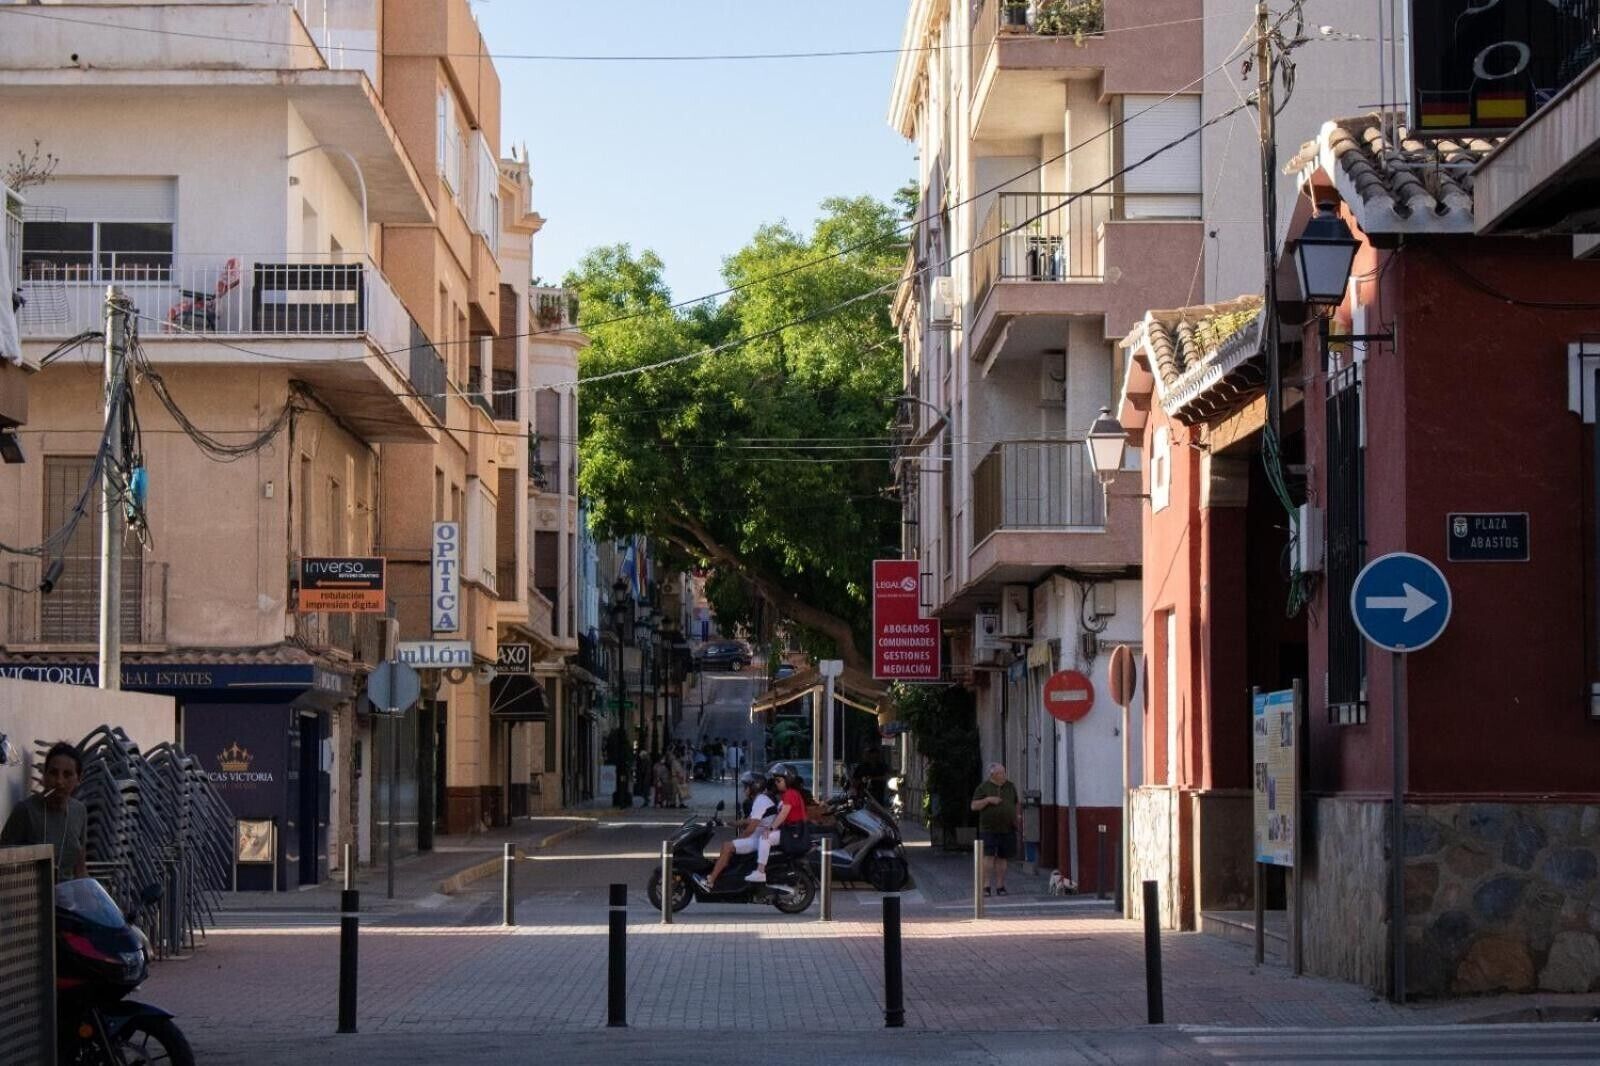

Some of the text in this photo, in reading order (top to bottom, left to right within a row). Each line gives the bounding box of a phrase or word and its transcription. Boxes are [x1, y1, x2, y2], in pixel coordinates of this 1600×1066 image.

[1475, 518, 1507, 530] PLAZA
[1471, 536, 1520, 549] ABASTOS
[436, 524, 456, 629] OPTICA
[876, 581, 901, 589] LEGAL
[352, 600, 380, 610] digital
[883, 624, 930, 634] ABOGADOS
[878, 637, 935, 648] COMUNIDADES
[883, 651, 930, 661] GESTIONES
[883, 663, 931, 674] MEDIACIÓN
[0, 666, 95, 684] VICTORIA
[157, 671, 213, 685] ESTATES
[229, 771, 273, 782] VICTORIA
